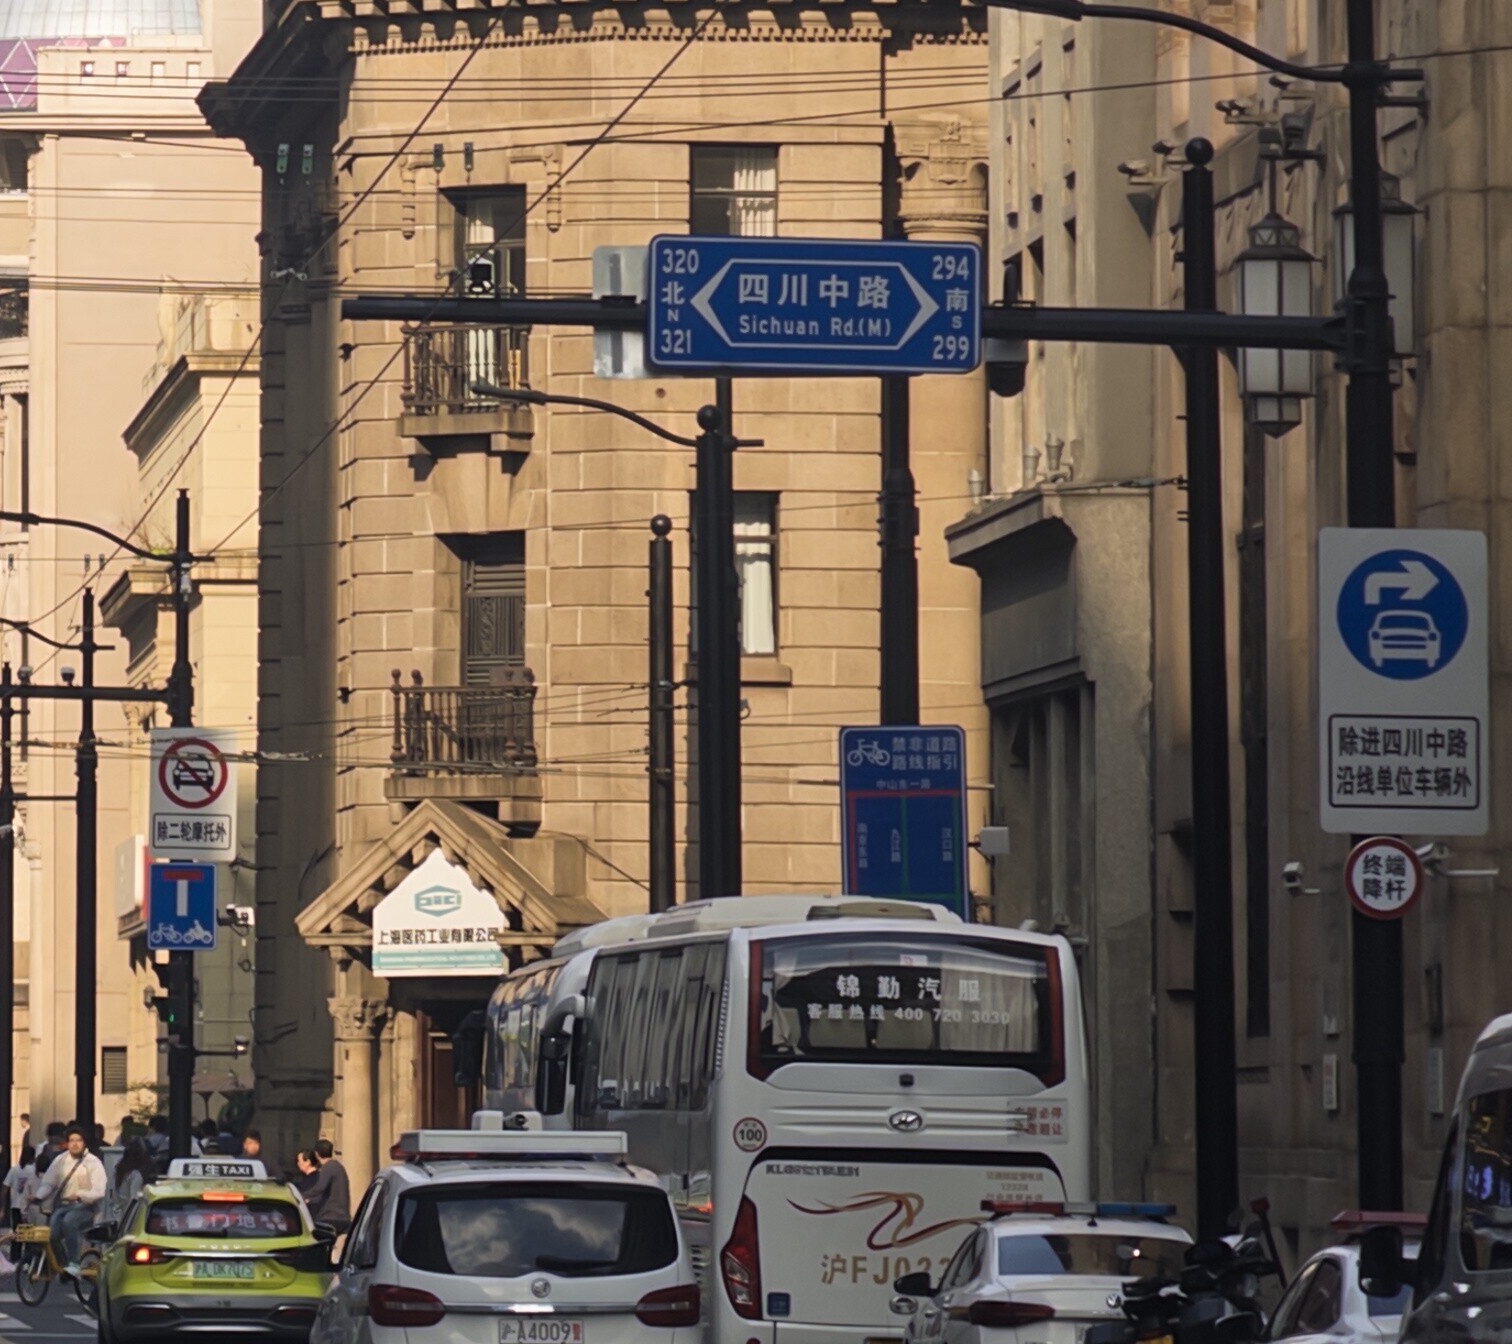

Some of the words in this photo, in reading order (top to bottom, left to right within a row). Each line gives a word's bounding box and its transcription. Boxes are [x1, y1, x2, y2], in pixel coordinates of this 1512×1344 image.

[661, 248, 700, 274] 320
[932, 255, 970, 281] 294
[661, 281, 685, 305] 北
[738, 273, 891, 310] 四川中路
[945, 288, 970, 312] 南
[667, 310, 679, 322] N
[739, 315, 820, 336] Sichuan
[830, 316, 891, 338] Rd.(M)
[952, 315, 962, 329] S
[660, 329, 692, 354] 321
[932, 335, 970, 361] 299
[891, 736, 958, 753] 禁非道路
[1337, 726, 1468, 758] 除进四川中路
[891, 754, 958, 771] 路线指引
[876, 778, 932, 790] 中山东一路
[1336, 765, 1472, 798] 沿线单位车辆外
[157, 820, 228, 843] 除二轮摩托外
[1362, 854, 1406, 877] 终端
[1362, 878, 1407, 901] 降杆
[377, 927, 499, 945] 上海医药工业有限公司
[836, 974, 982, 1002] 锦勤汽服
[806, 1002, 885, 1021] 客服热线
[894, 1006, 924, 1021] 400
[933, 1007, 962, 1023] 720
[971, 1011, 1011, 1025] 3030
[738, 1128, 763, 1142] 100
[221, 1164, 250, 1176] TAXI
